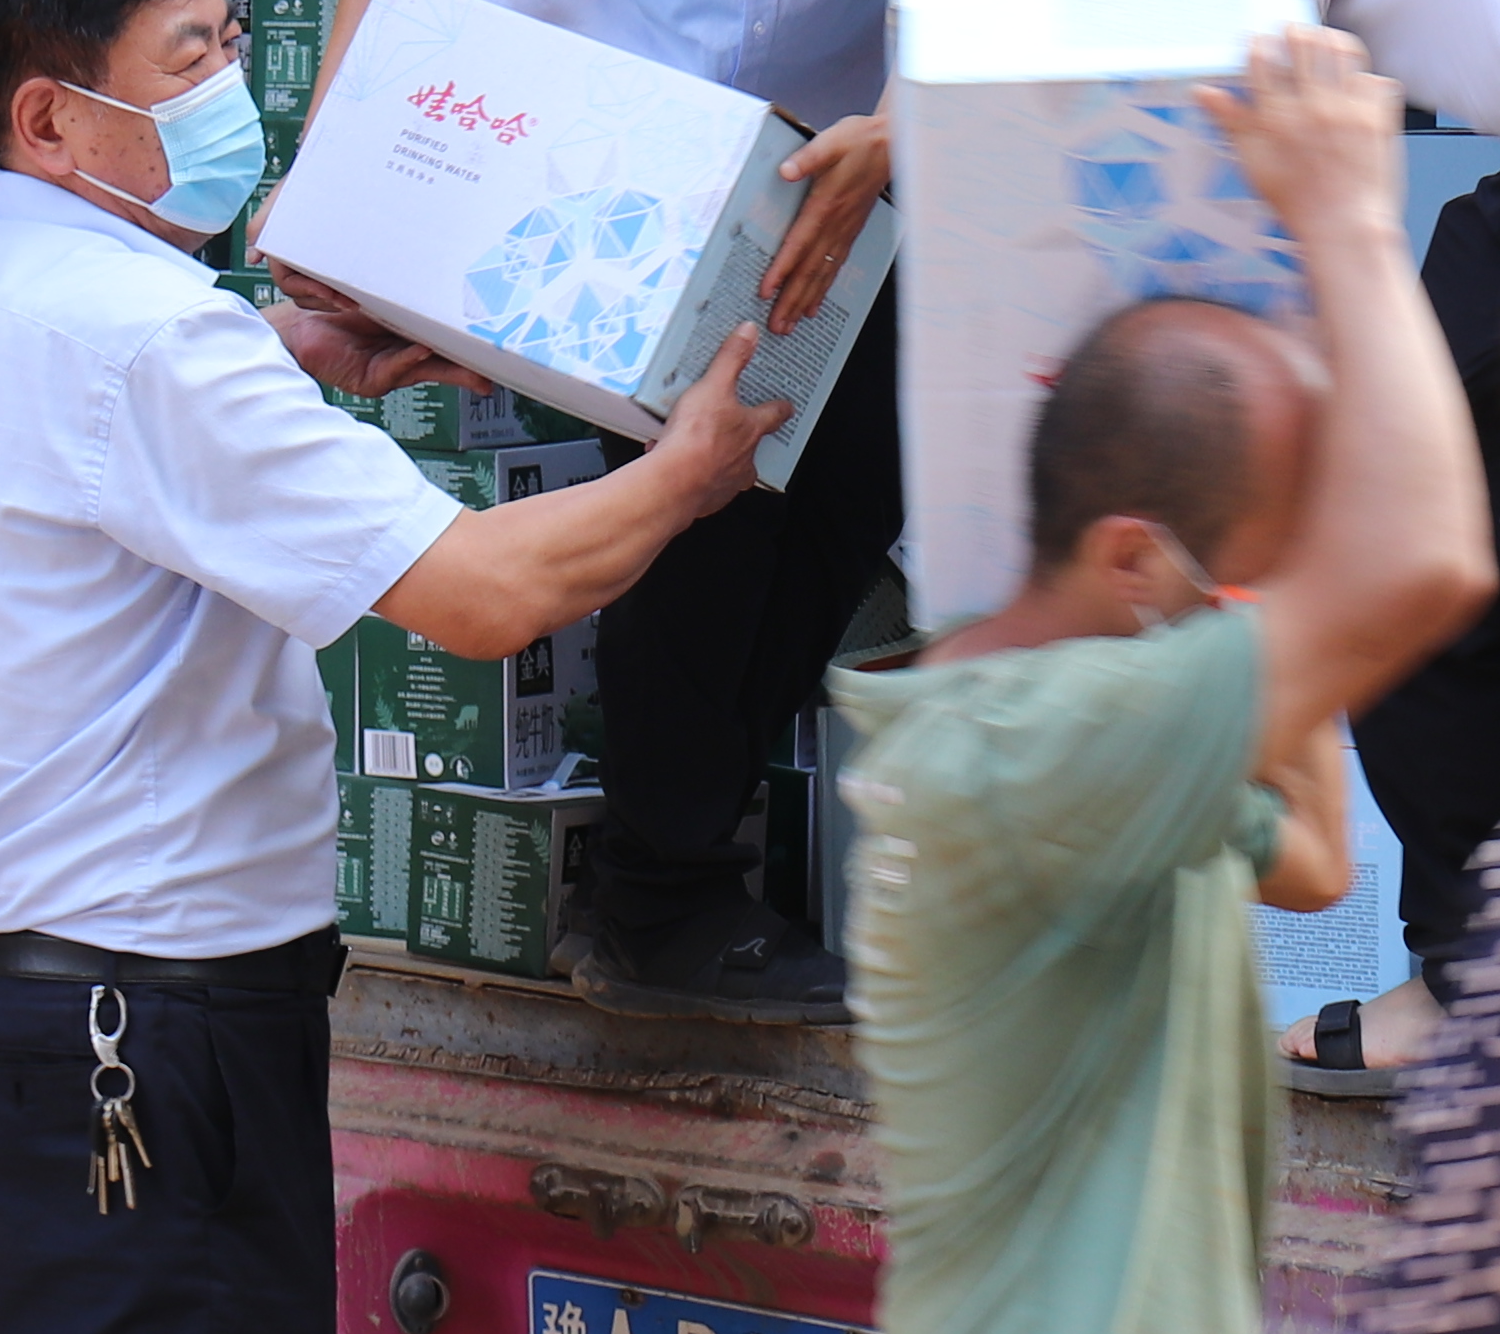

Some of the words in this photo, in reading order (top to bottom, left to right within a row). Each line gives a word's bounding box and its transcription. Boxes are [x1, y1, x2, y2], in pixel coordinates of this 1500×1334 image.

[406, 80, 529, 146] 娃哈哈
[400, 128, 449, 153] PURIFIED
[392, 143, 443, 169] DRINKING
[444, 164, 482, 184] WATER
[520, 643, 551, 682] 金典
[515, 705, 555, 760] 纯牛奶
